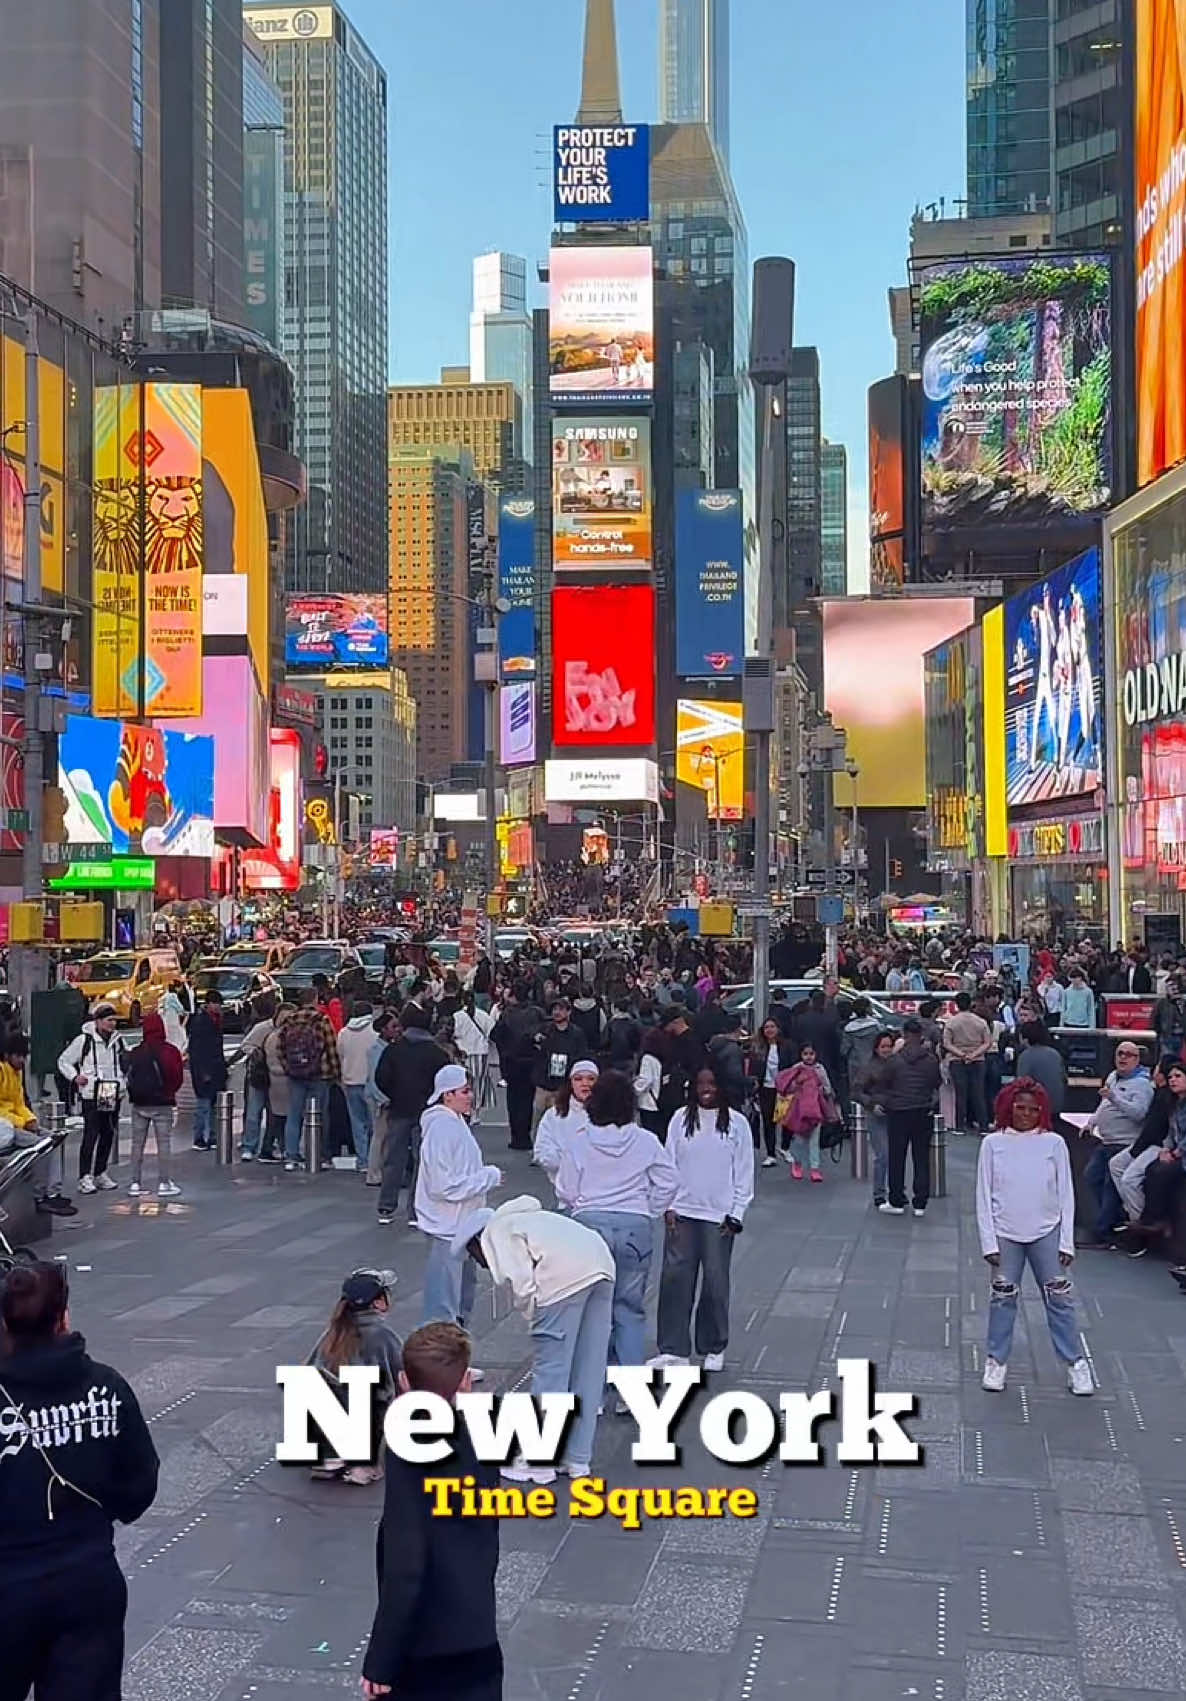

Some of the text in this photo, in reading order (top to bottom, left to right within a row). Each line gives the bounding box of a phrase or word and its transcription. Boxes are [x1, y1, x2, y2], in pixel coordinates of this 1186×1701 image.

[558, 128, 636, 147] PROTECT
[557, 147, 606, 166] YOUR
[558, 166, 608, 185] LIFE'S
[558, 185, 612, 204] WORK
[244, 154, 268, 305] TIMES
[951, 360, 1017, 374] Life's Good
[952, 377, 1081, 394] when you help protect
[951, 398, 1071, 413] endangered species
[565, 427, 638, 440] SAMSUNG
[570, 542, 634, 552] hands-free
[154, 585, 191, 598] NOW IS
[148, 598, 167, 612] THE
[1124, 662, 1160, 726] OLD
[61, 845, 73, 860] W
[79, 845, 96, 859] 44
